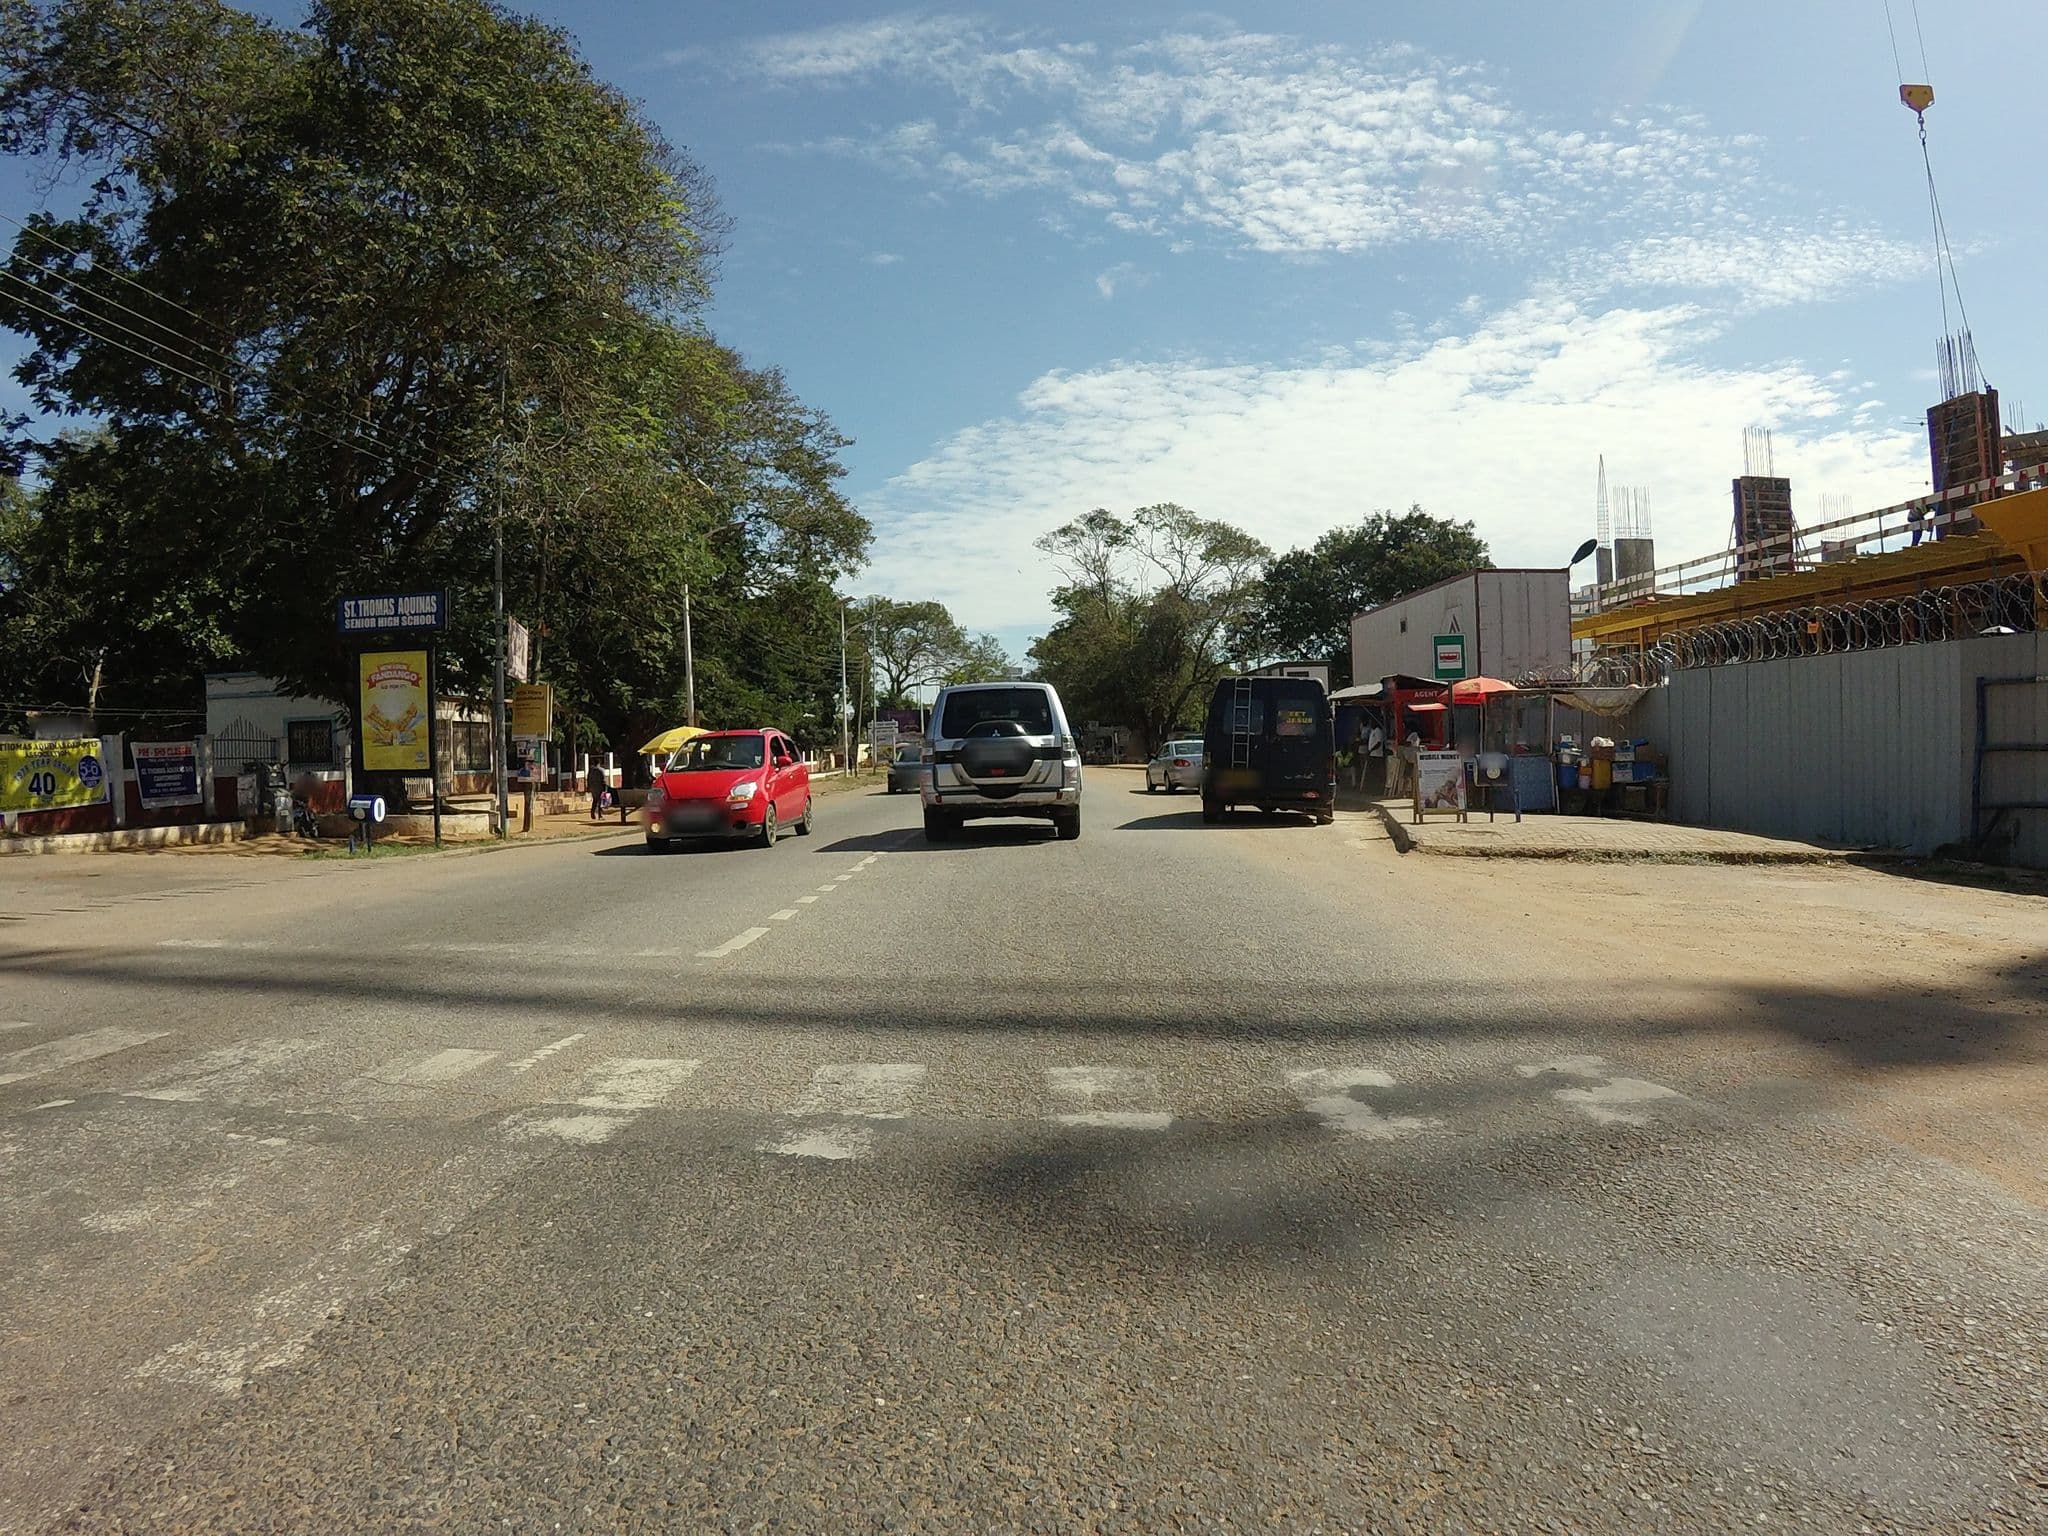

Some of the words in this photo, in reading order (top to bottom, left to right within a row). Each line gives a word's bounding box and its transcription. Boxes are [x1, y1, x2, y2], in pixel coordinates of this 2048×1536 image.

[344, 601, 357, 618] ST.
[358, 598, 395, 617] THOMAS
[398, 595, 437, 616] AQUINAS
[345, 618, 376, 629] SENIOR
[378, 616, 400, 627] HIGH
[401, 614, 437, 626] SCHOOL
[370, 670, 418, 682] FANDANGO
[1414, 690, 1439, 698] AGENT
[28, 771, 56, 796] 40
